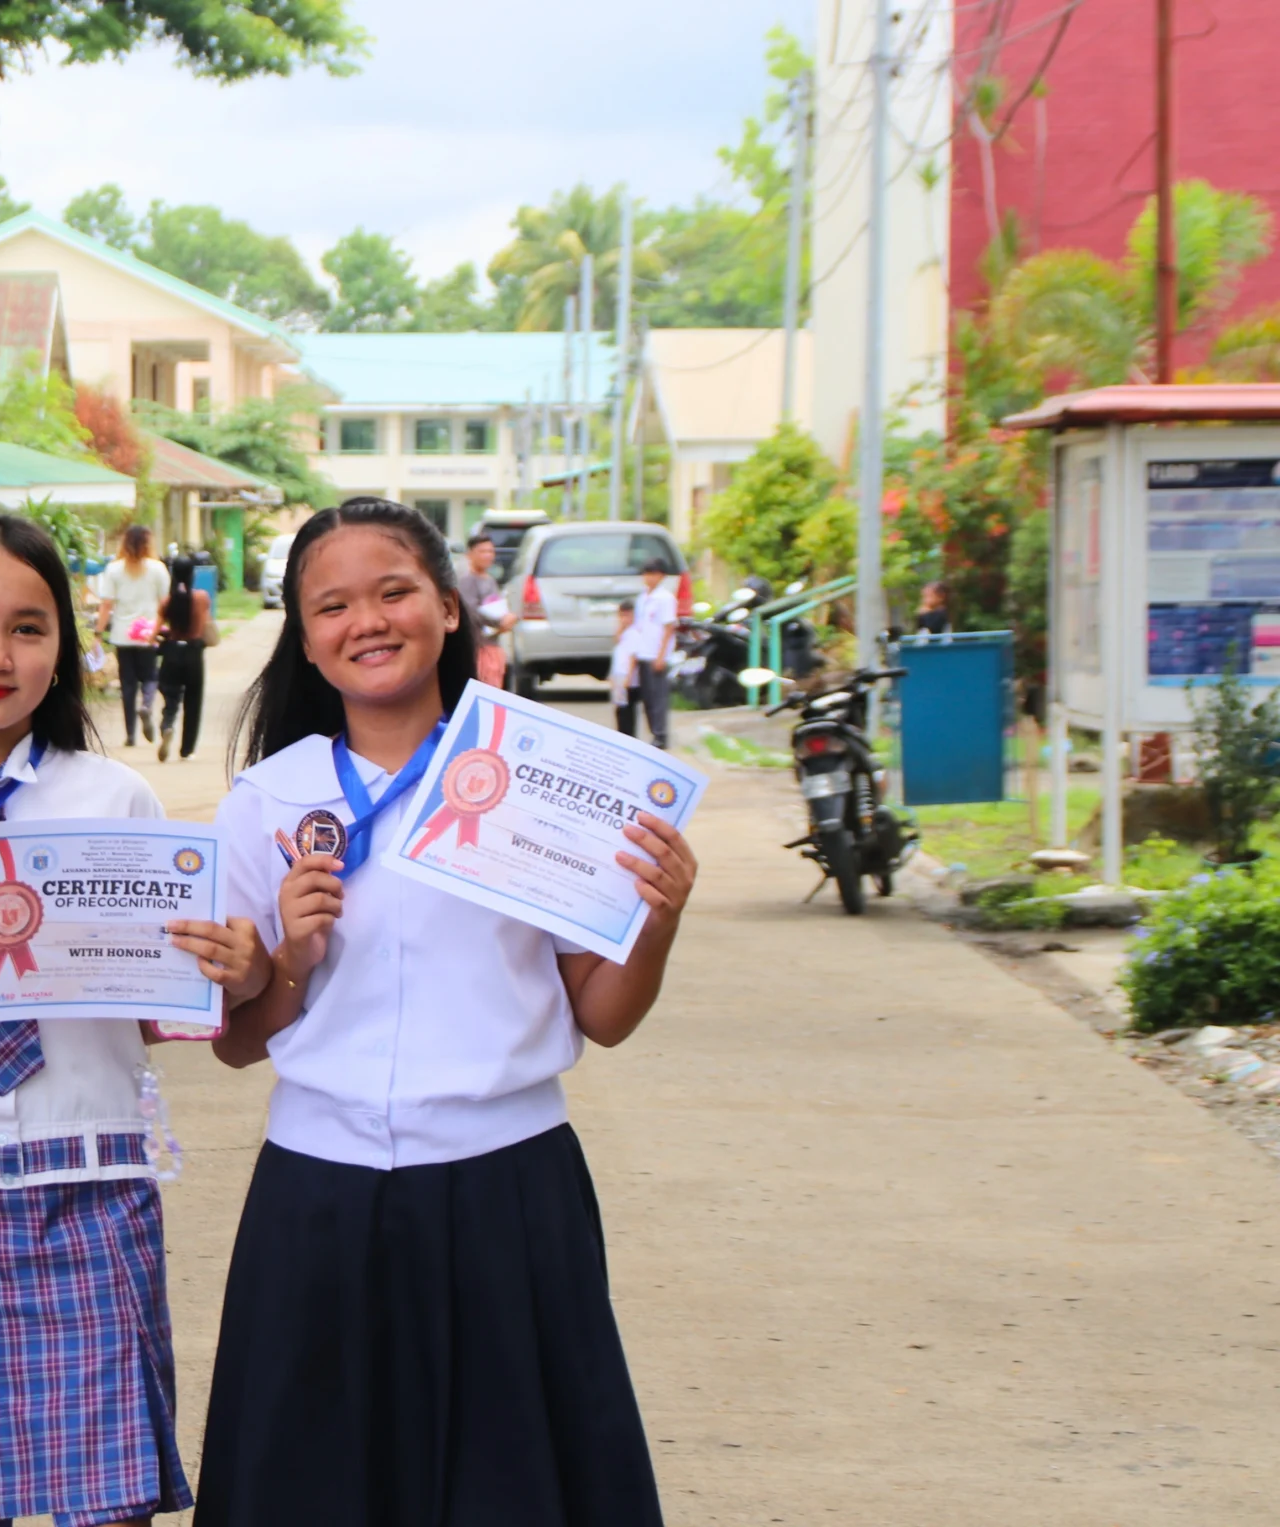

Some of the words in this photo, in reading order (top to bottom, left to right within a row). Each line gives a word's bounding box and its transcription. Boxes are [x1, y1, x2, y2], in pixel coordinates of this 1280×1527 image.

[515, 763, 645, 822] CERTIFICAT
[520, 784, 539, 799] OF
[540, 790, 624, 831] RECOGNITIO
[512, 834, 542, 856] WITH
[544, 844, 597, 876] HONORS
[42, 880, 192, 899] CERTIFICATE
[55, 896, 74, 908] OF
[78, 896, 178, 910] RECOGNITION
[68, 948, 103, 958] WITH
[107, 948, 162, 959] HONORS
